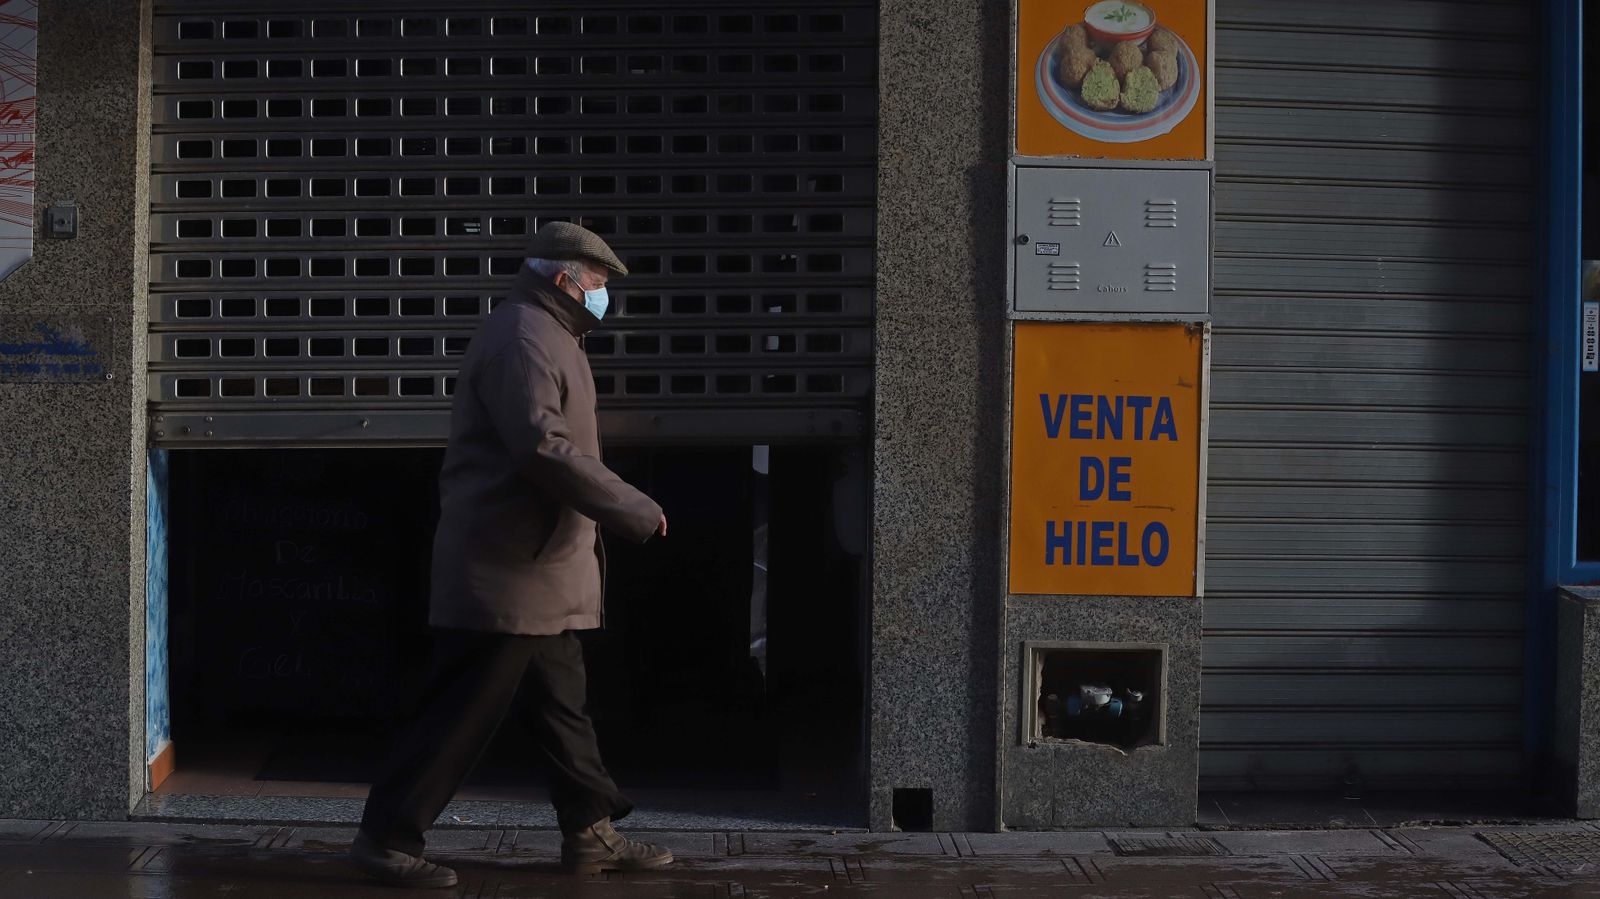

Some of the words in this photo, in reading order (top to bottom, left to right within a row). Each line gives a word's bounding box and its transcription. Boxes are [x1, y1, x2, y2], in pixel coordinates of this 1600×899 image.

[1040, 394, 1178, 440] VENTA
[1080, 456, 1132, 501] DE
[1045, 521, 1169, 566] HIELO
